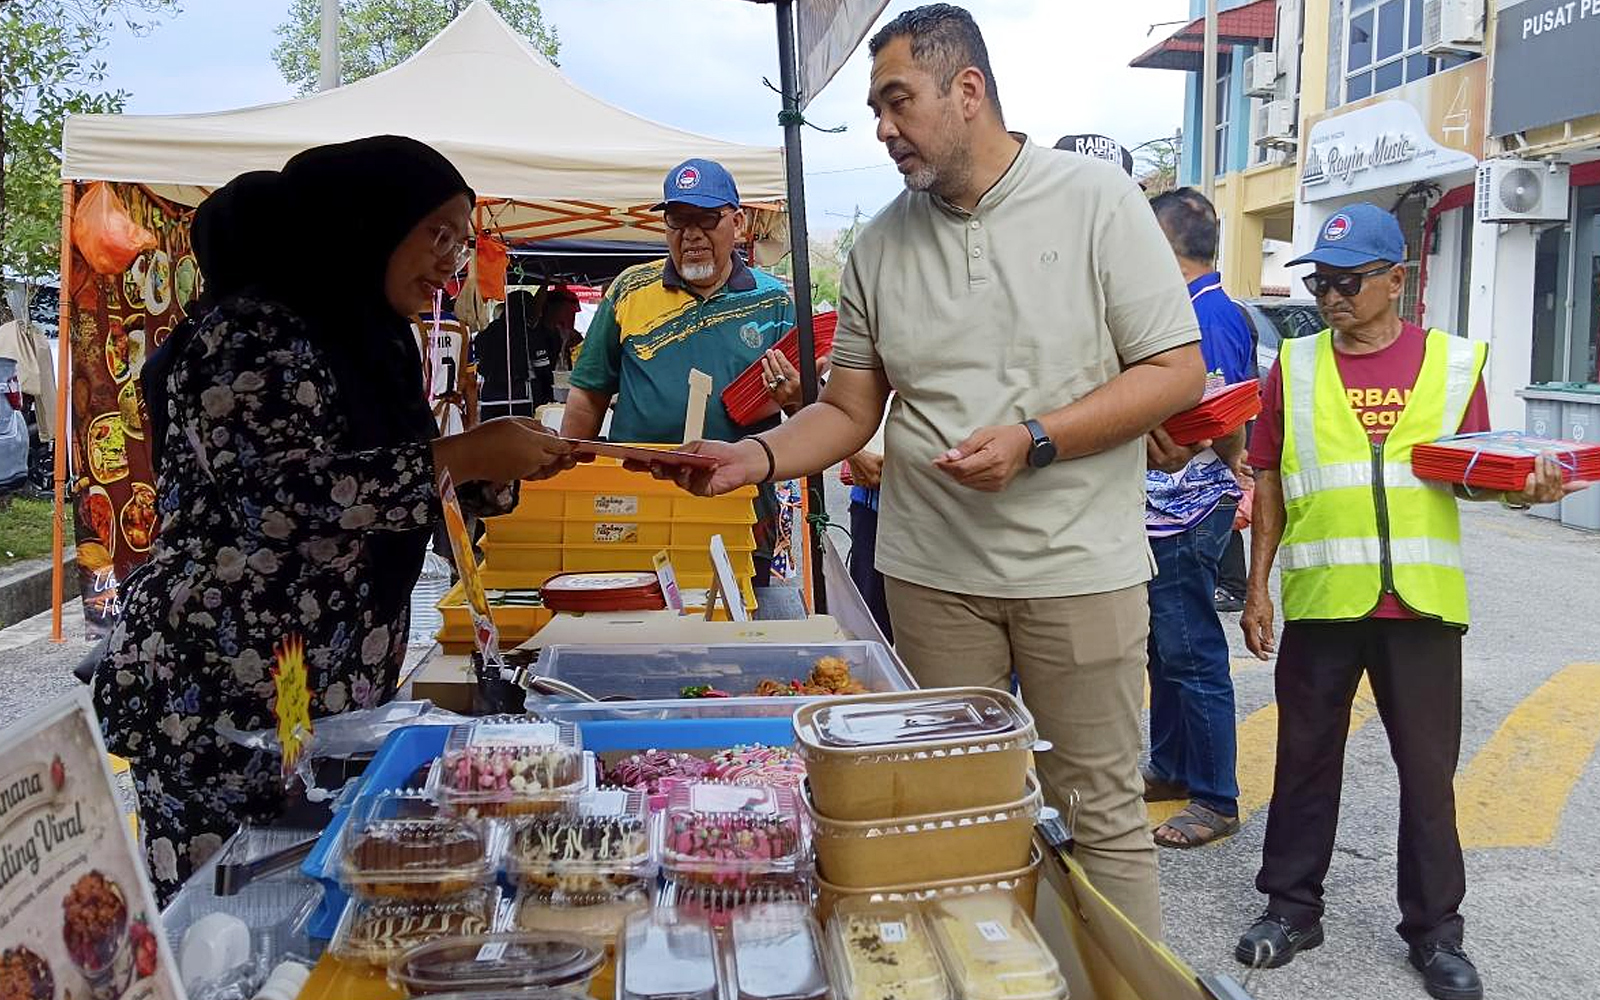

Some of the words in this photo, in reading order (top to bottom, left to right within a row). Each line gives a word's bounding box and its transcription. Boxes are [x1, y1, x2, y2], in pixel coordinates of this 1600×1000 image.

[1522, 2, 1575, 39] PUSAT
[1369, 134, 1412, 165] Music
[0, 773, 43, 816] nana
[0, 836, 40, 888] ding
[34, 801, 85, 852] Viral
